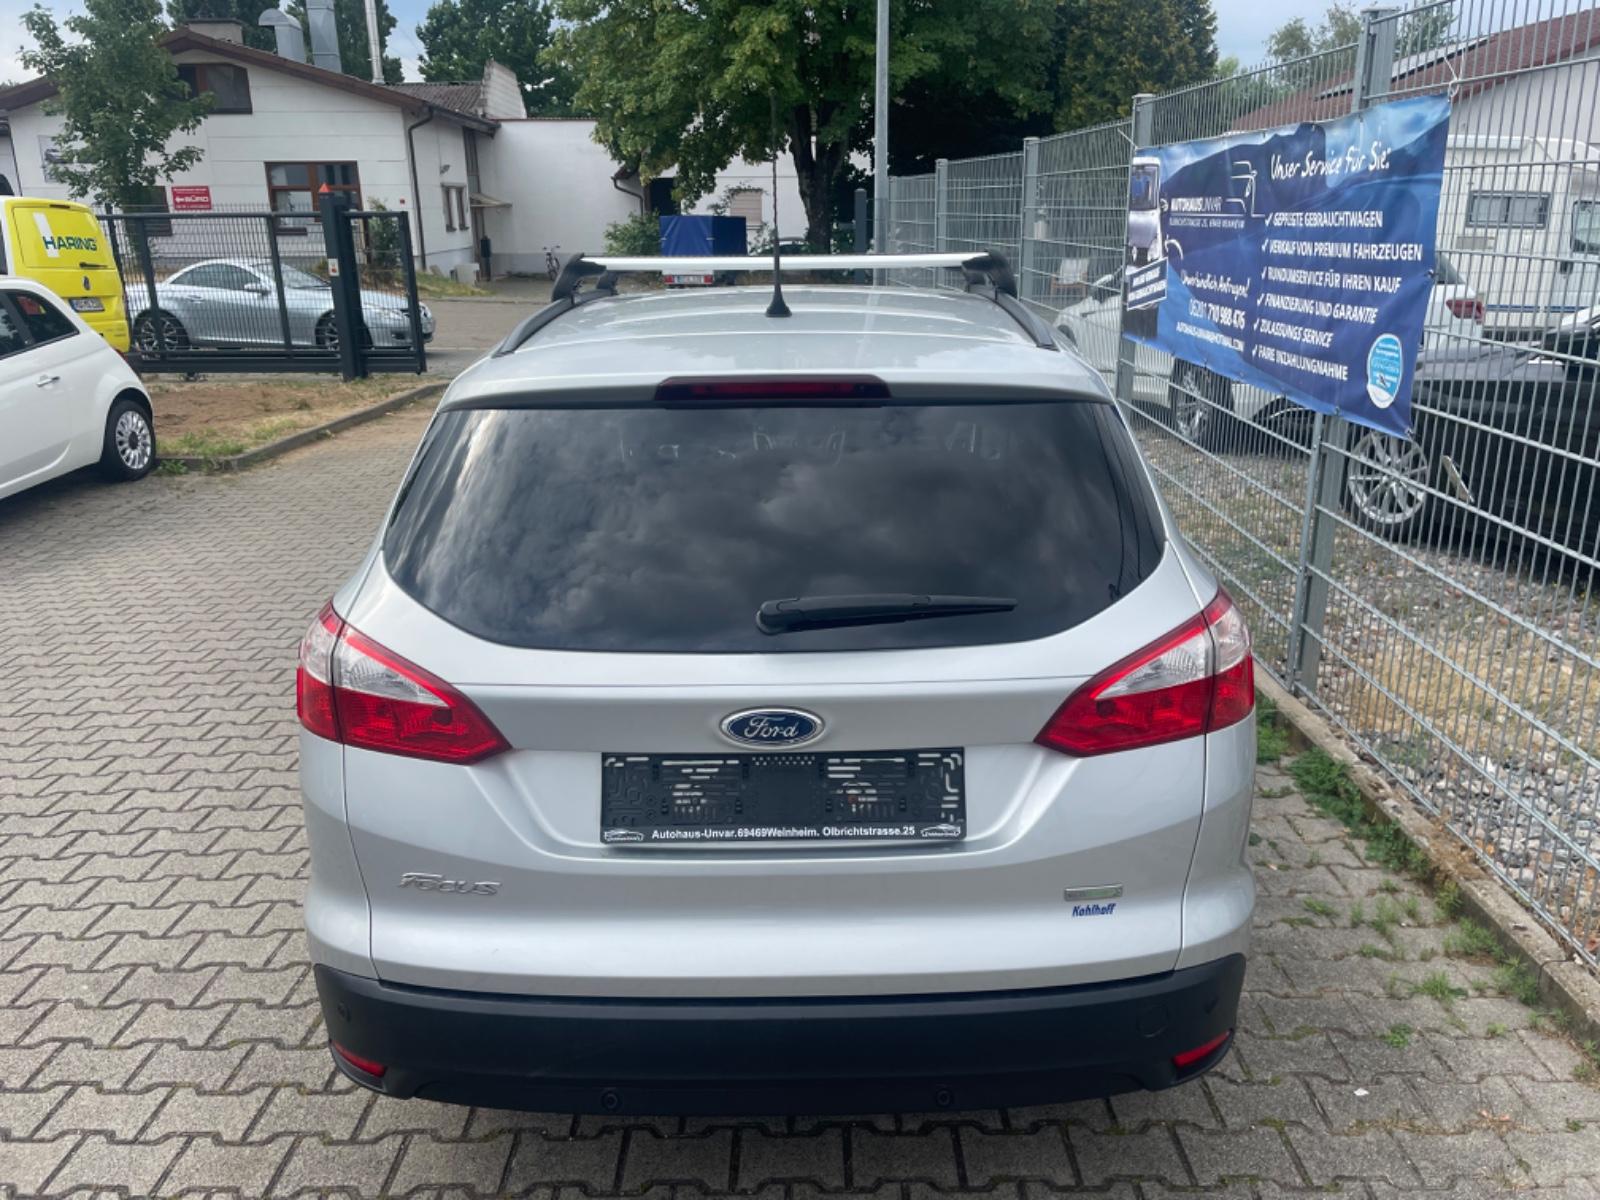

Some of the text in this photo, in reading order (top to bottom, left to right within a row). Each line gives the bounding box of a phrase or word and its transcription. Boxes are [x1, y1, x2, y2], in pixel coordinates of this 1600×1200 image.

[1271, 153, 1300, 180] Unser
[1301, 150, 1342, 177] Service
[1304, 210, 1383, 228] GEBRAUCHTWAGEN
[42, 235, 97, 252] HARING
[1296, 240, 1313, 257] VON
[1314, 241, 1351, 259] PREMIUM
[1353, 242, 1423, 262] FAHRZEUGEN
[1324, 268, 1341, 288] FÜR
[1342, 273, 1372, 291] IHREN
[1374, 276, 1402, 293] KAUF
[1265, 293, 1379, 324] FINANZIERUNG UND GARANTIE
[1301, 328, 1334, 348] SERVICE
[744, 716, 799, 738] Ford
